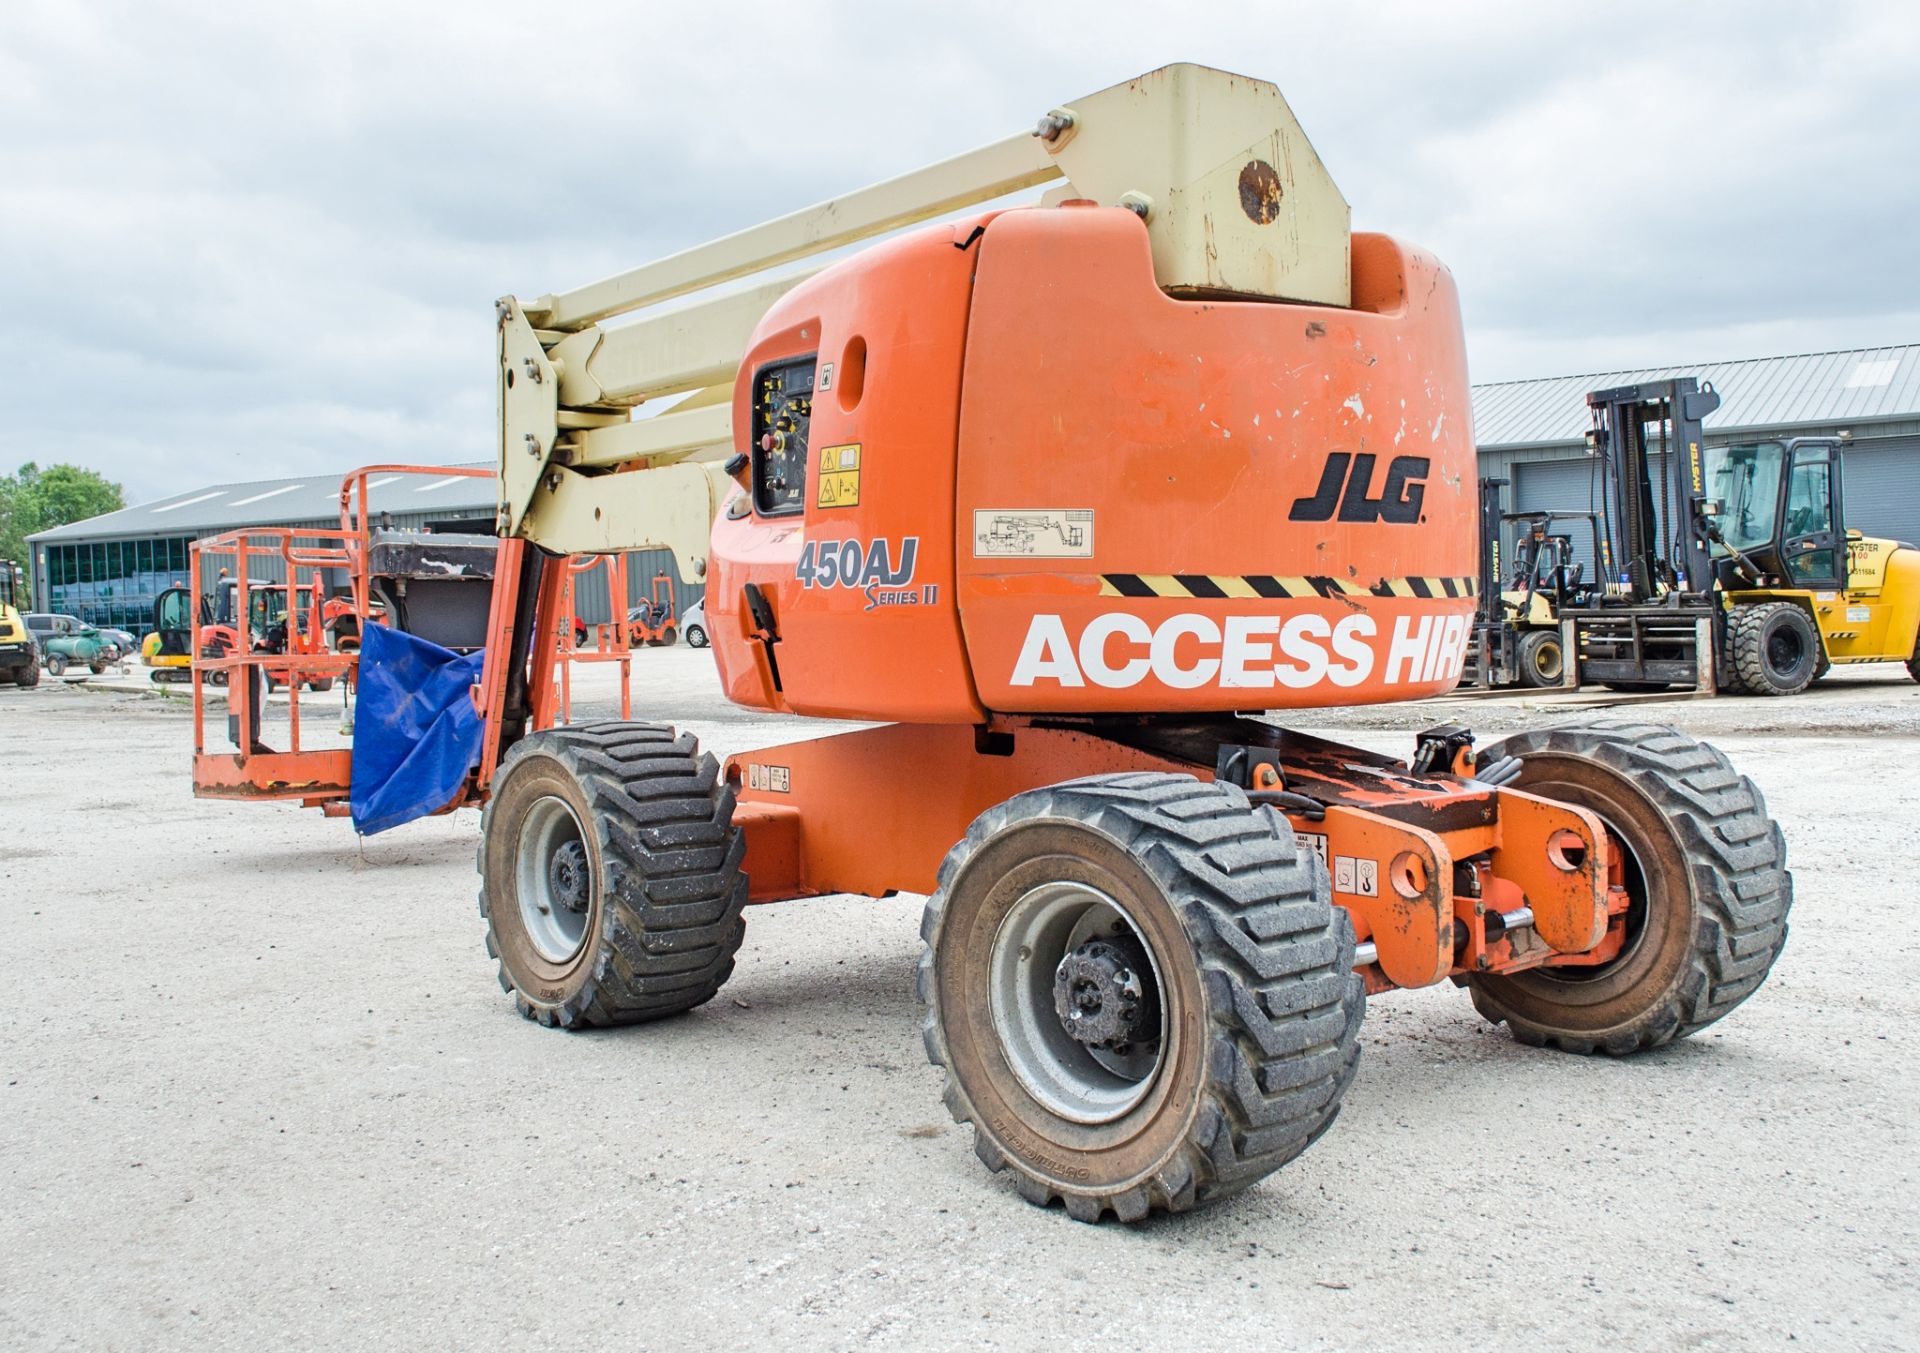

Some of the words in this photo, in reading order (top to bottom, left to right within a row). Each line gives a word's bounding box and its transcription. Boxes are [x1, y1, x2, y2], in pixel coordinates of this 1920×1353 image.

[1288, 452, 1430, 524] JLG
[1689, 442, 1701, 493] HYSTER
[796, 537, 919, 589] 450AJ
[922, 584, 939, 605] II
[1009, 612, 1377, 689] ACCESS
[993, 1118, 1090, 1180] OUTRIGGER
